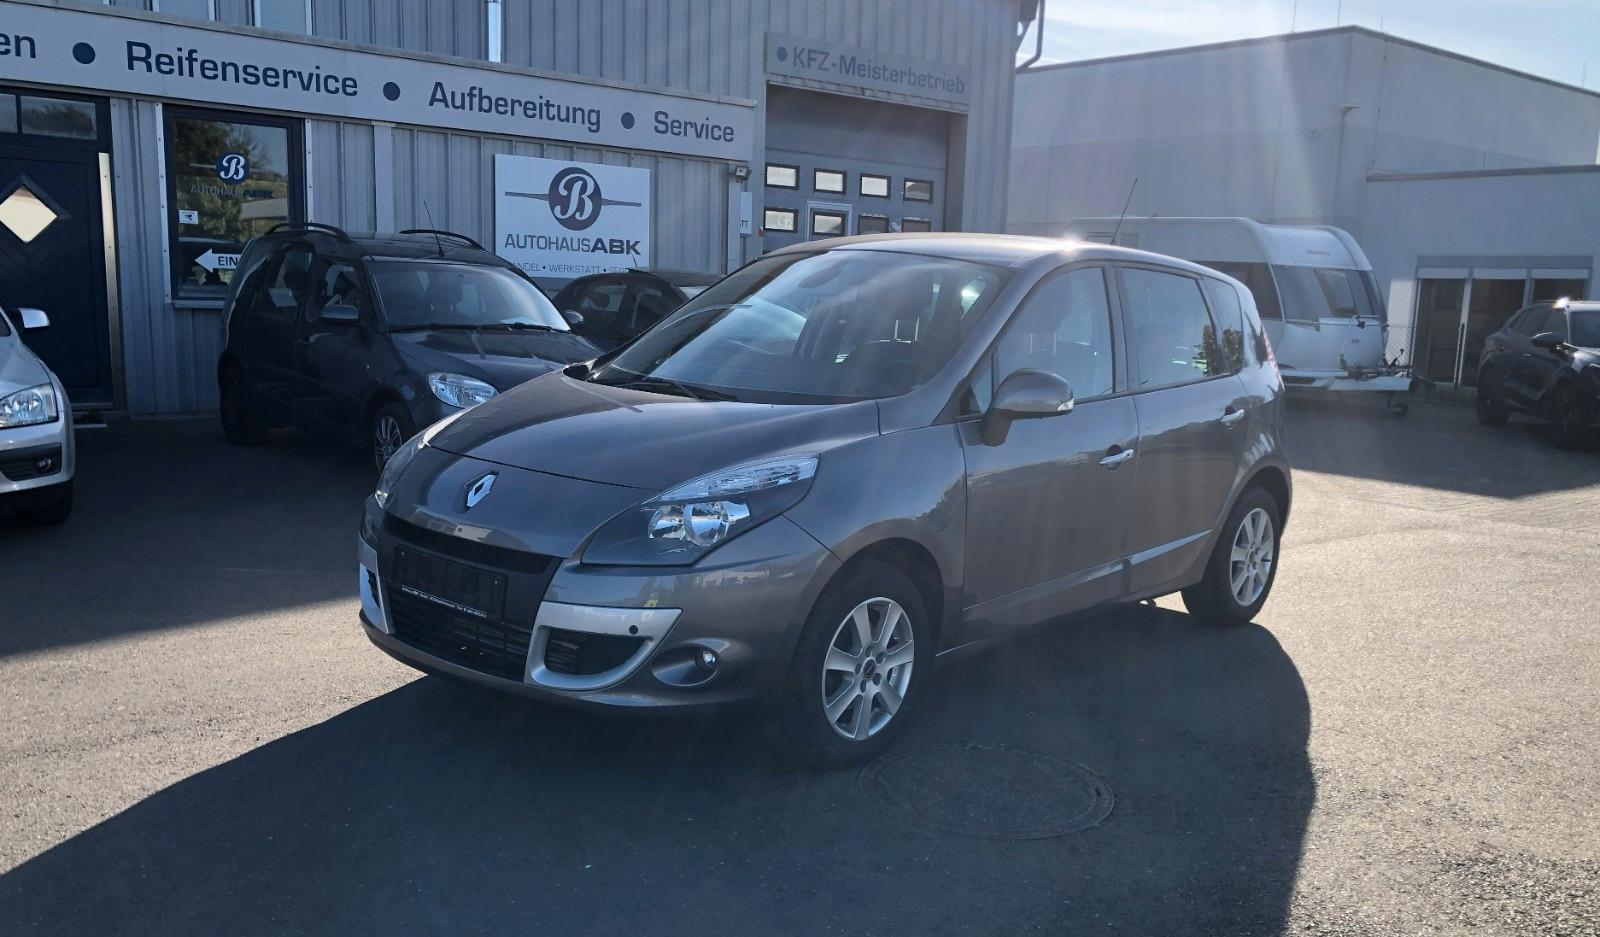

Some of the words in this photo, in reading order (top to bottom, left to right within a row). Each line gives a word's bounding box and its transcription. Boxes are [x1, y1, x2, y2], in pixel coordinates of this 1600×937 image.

[792, 46, 965, 95] KFZ-Meisterbetrieb
[126, 40, 358, 97] Reifenservice
[428, 81, 601, 133] Aufbereitung
[653, 111, 735, 142] Service
[217, 255, 239, 267] EIN
[549, 264, 600, 274] WERKSTATT
